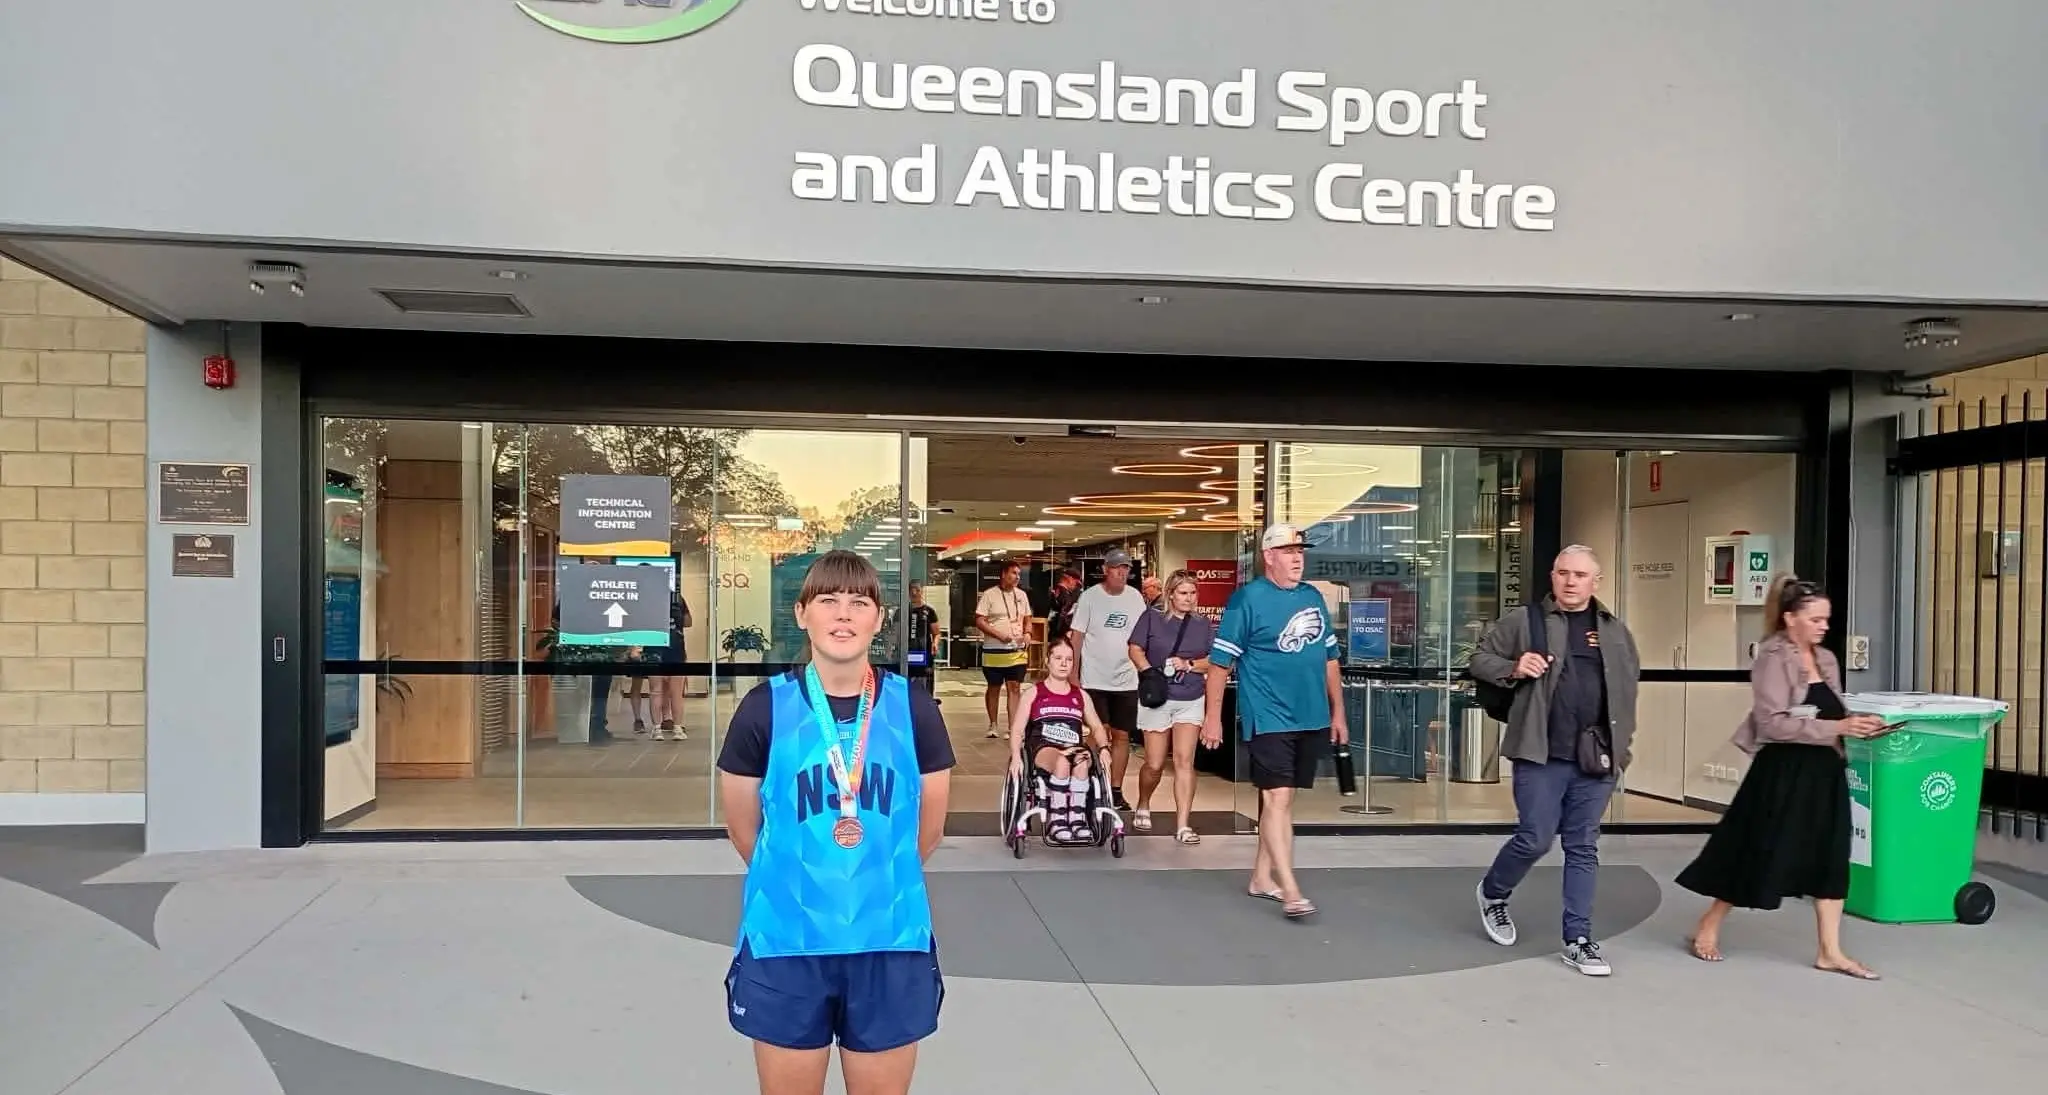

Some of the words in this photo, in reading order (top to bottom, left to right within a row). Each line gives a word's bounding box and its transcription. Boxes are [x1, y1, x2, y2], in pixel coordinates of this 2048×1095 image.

[1012, 0, 1056, 24] to
[792, 43, 1256, 128] Queensland
[1275, 70, 1488, 147] Sport
[791, 143, 937, 205] and
[953, 145, 1296, 220] Athletics
[1313, 162, 1557, 232] Centre
[585, 498, 645, 508] TECHNICAL
[578, 509, 653, 519] INFORMATION
[594, 520, 636, 530] CENTRE
[1750, 575, 1768, 583] AED
[591, 580, 637, 590] ATHLETE
[589, 591, 625, 601] CHECK
[627, 592, 639, 601] IN
[1351, 617, 1387, 625] WELCOME
